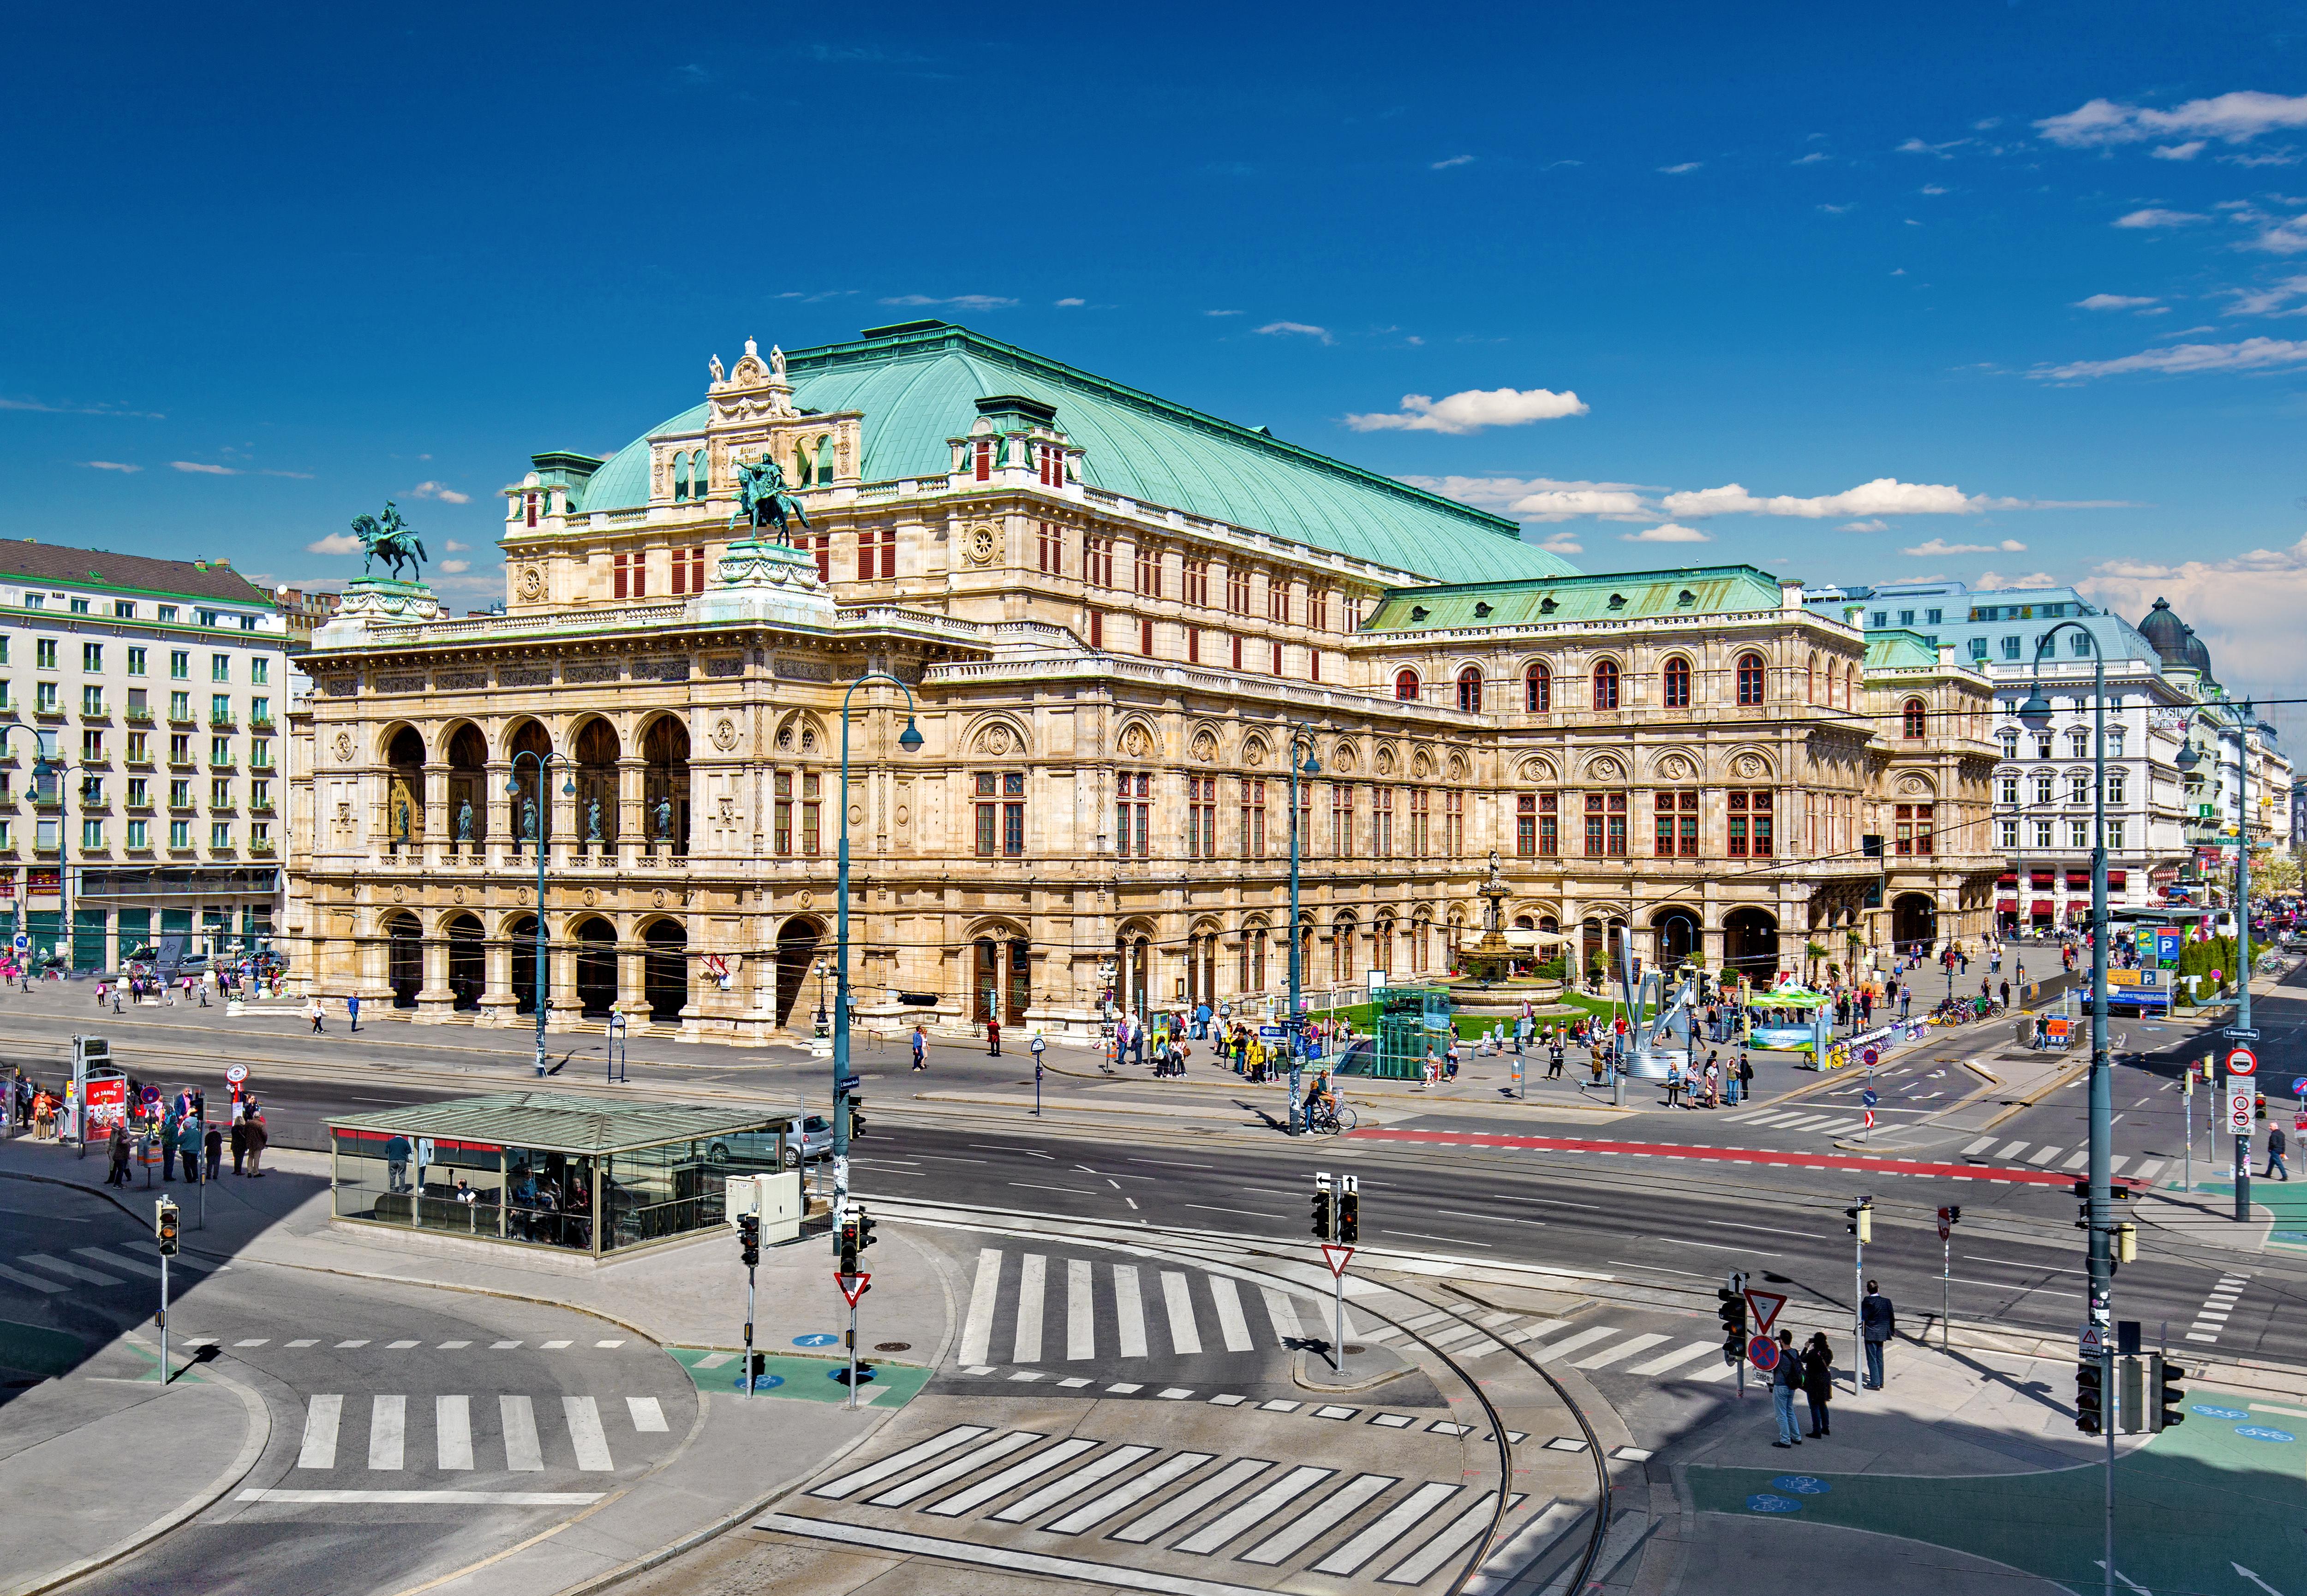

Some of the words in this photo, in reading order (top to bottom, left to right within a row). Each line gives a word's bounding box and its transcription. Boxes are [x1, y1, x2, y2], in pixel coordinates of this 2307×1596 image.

[739, 447, 757, 456] Kaiser
[2162, 940, 2173, 953] P
[2231, 1126, 2252, 1134] Zone
[1756, 1372, 1770, 1381] Ende
